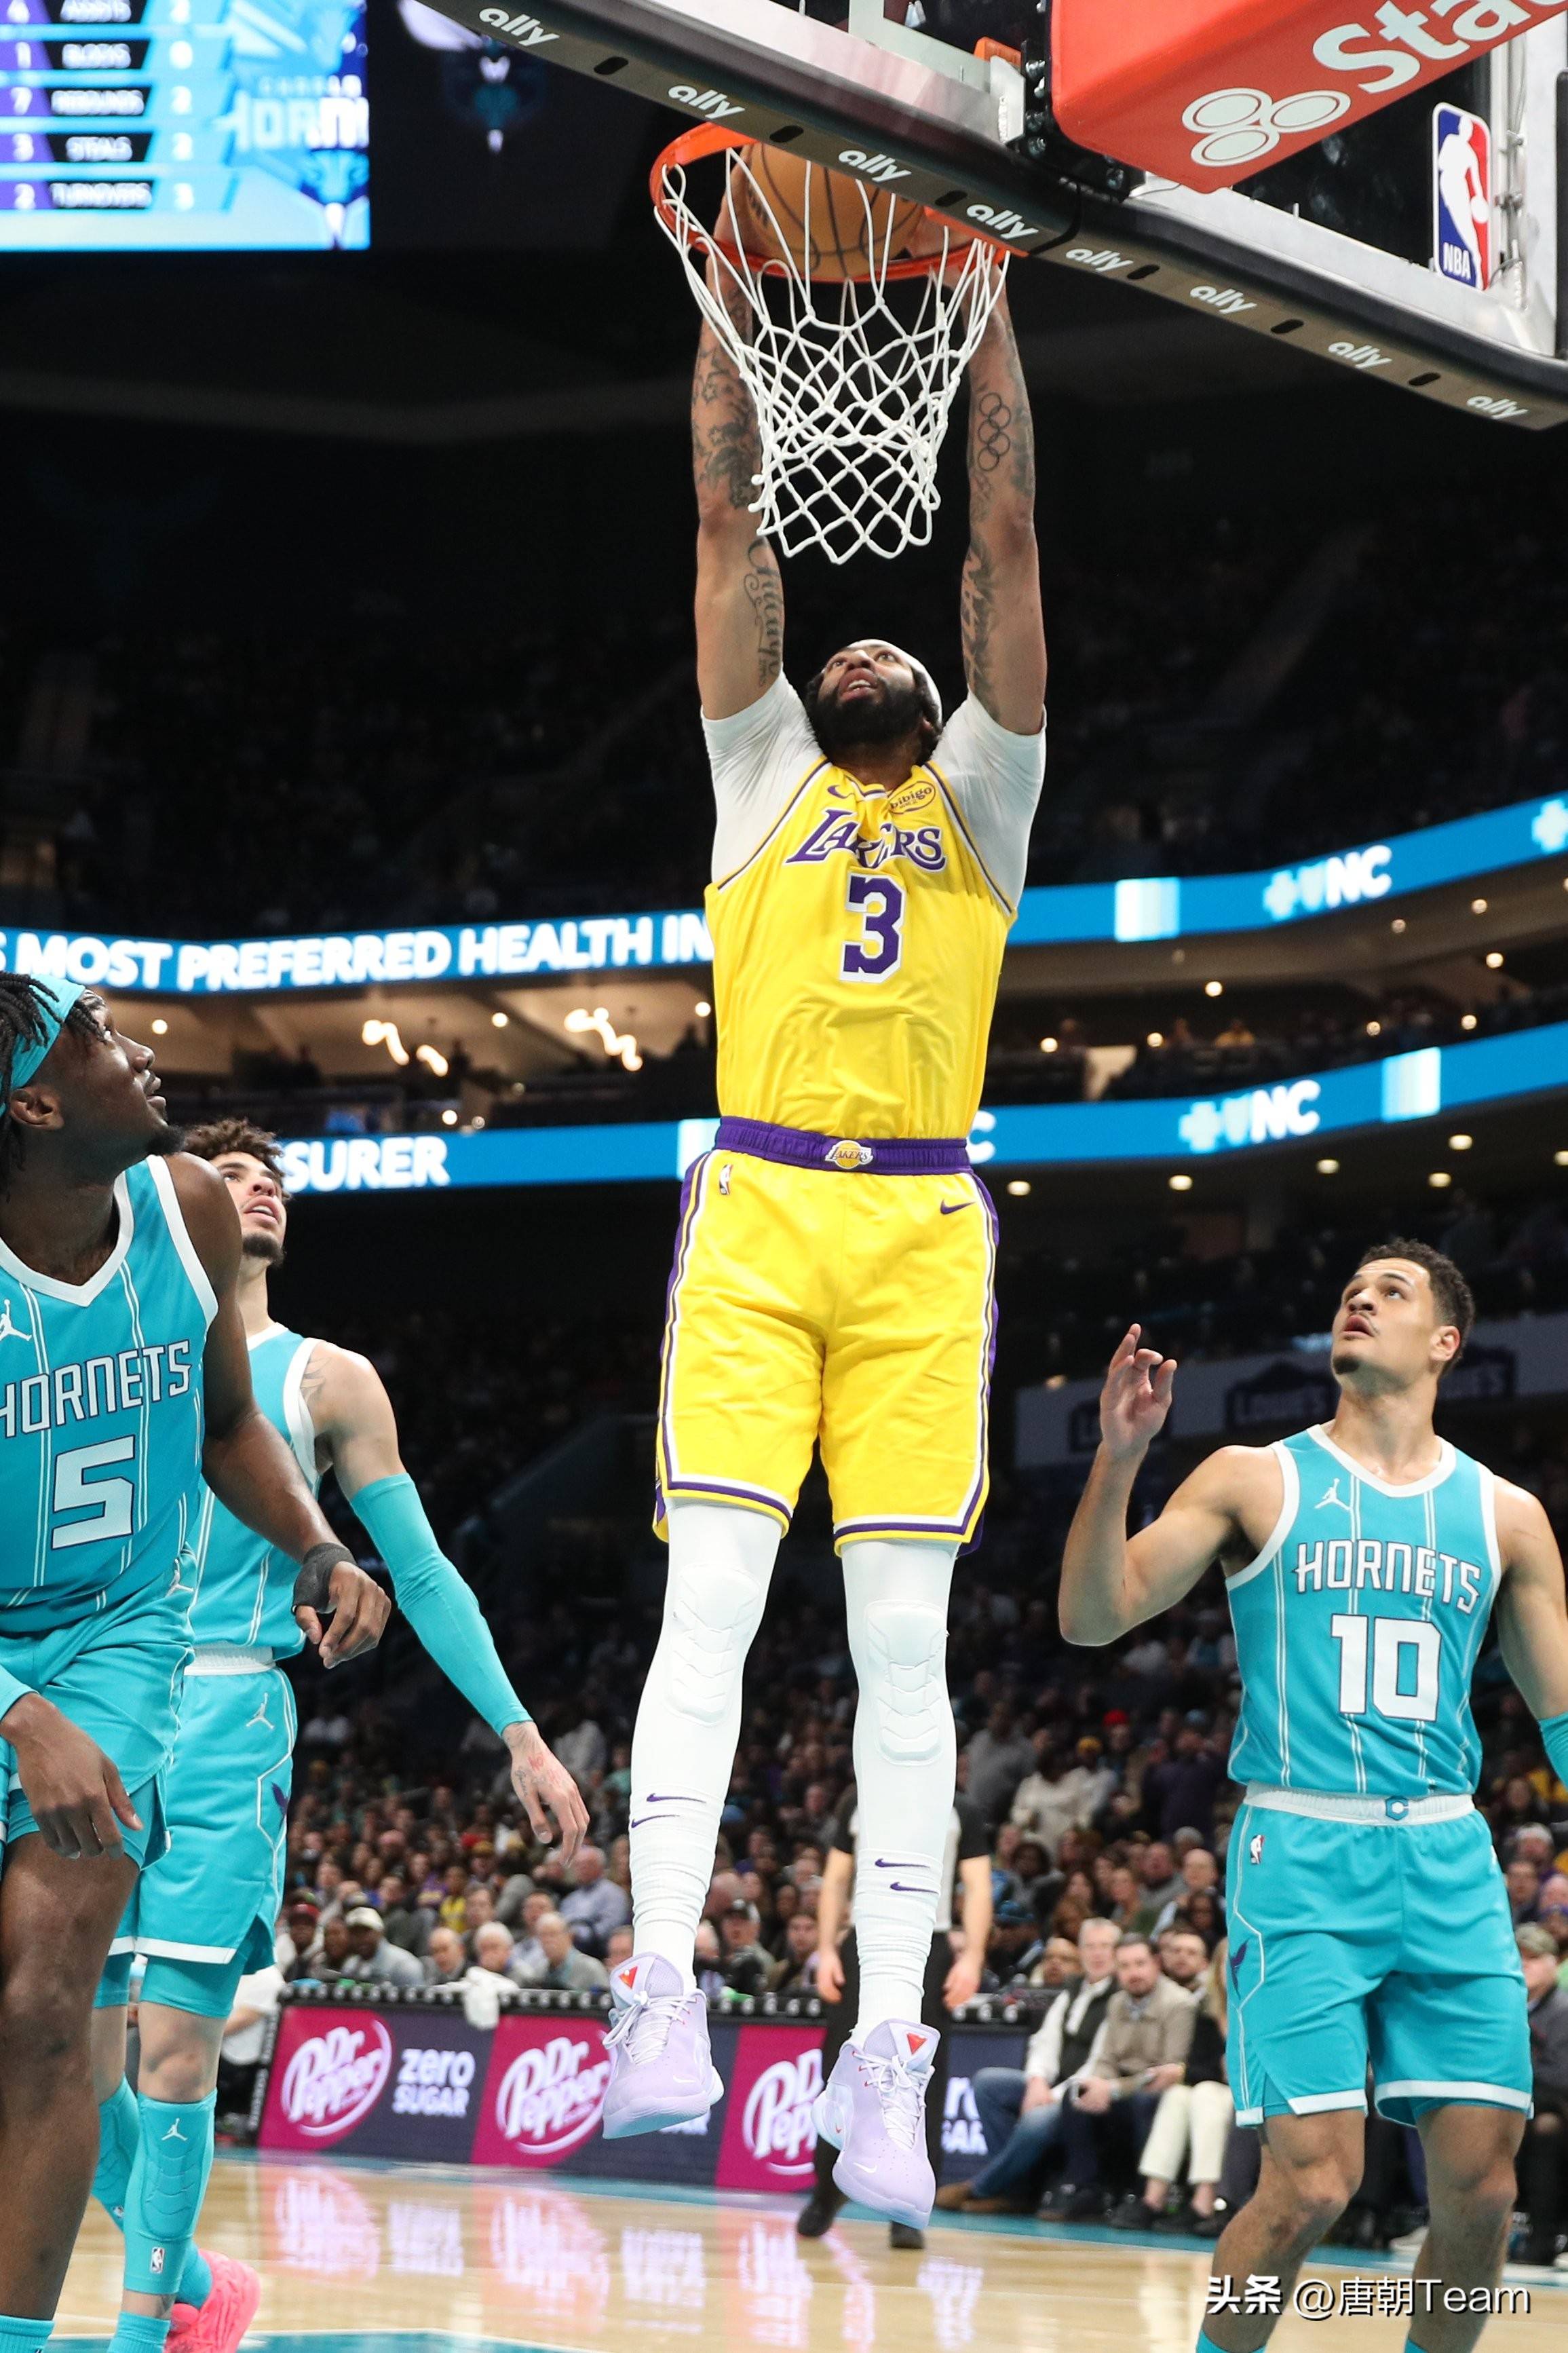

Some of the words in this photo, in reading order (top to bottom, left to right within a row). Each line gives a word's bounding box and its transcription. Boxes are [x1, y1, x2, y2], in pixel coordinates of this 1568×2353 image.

[478, 7, 559, 47] ally
[1312, 0, 1568, 94] Sta
[668, 84, 745, 120] ally
[839, 150, 912, 183] ally
[965, 204, 1039, 241] ally
[1065, 247, 1133, 272] ally
[1442, 242, 1471, 280] NBA
[1189, 284, 1255, 315] ally
[1328, 341, 1392, 369] ally
[1466, 394, 1527, 421] ally
[890, 787, 932, 809] bibigo
[840, 873, 905, 983] 3
[15, 933, 172, 988] MOST
[177, 930, 452, 991] PREFERRED
[459, 916, 653, 975] HEALTH
[828, 1146, 869, 1164] LAKERS
[51, 1434, 135, 1549] 5
[1293, 1538, 1481, 1615] HORNETS
[1331, 1613, 1441, 1721] 10
[325, 2027, 366, 2067] Dr
[545, 2037, 589, 2088] Dr
[281, 2037, 384, 2122] Pepper
[397, 2048, 475, 2088] zero
[797, 2048, 824, 2103] D
[392, 2084, 470, 2117] SUGAR
[496, 2048, 612, 2139] Pepper
